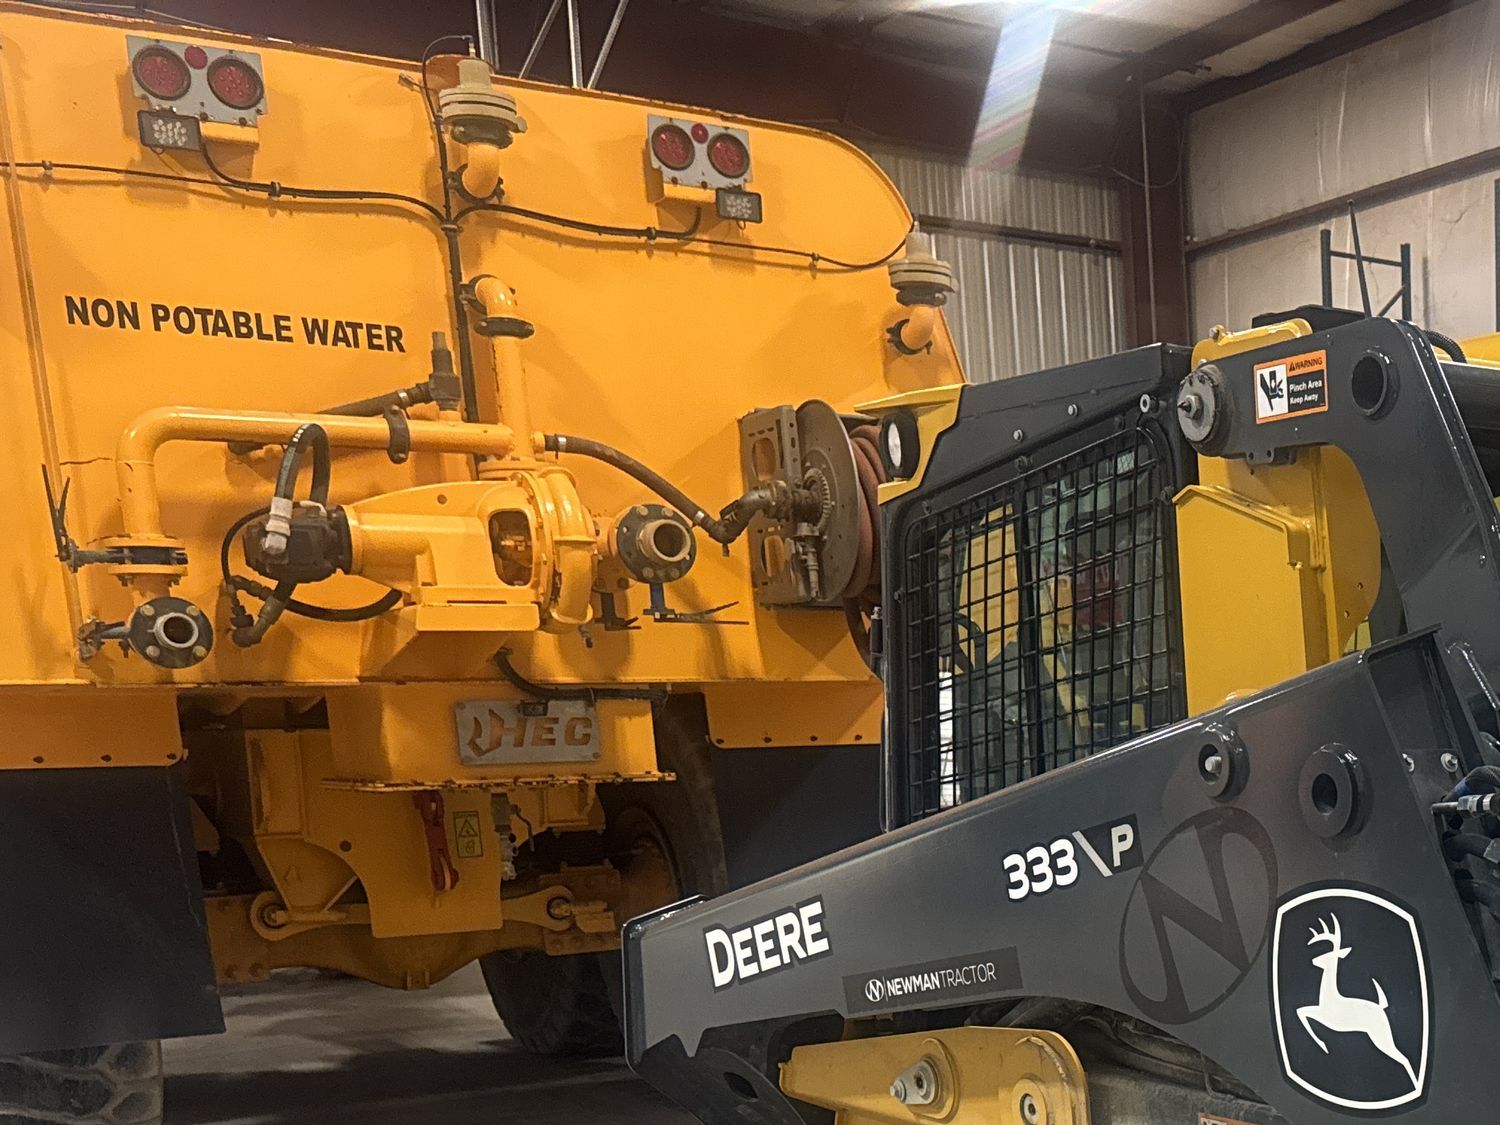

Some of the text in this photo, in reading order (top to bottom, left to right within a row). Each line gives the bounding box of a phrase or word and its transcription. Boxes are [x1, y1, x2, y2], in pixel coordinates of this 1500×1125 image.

[64, 295, 406, 353] NON POTABLE WATER
[1295, 357, 1322, 370] WARNING
[1289, 380, 1322, 393] Pinch Area
[1290, 394, 1318, 405] Keep Away
[705, 901, 830, 988] DEERE
